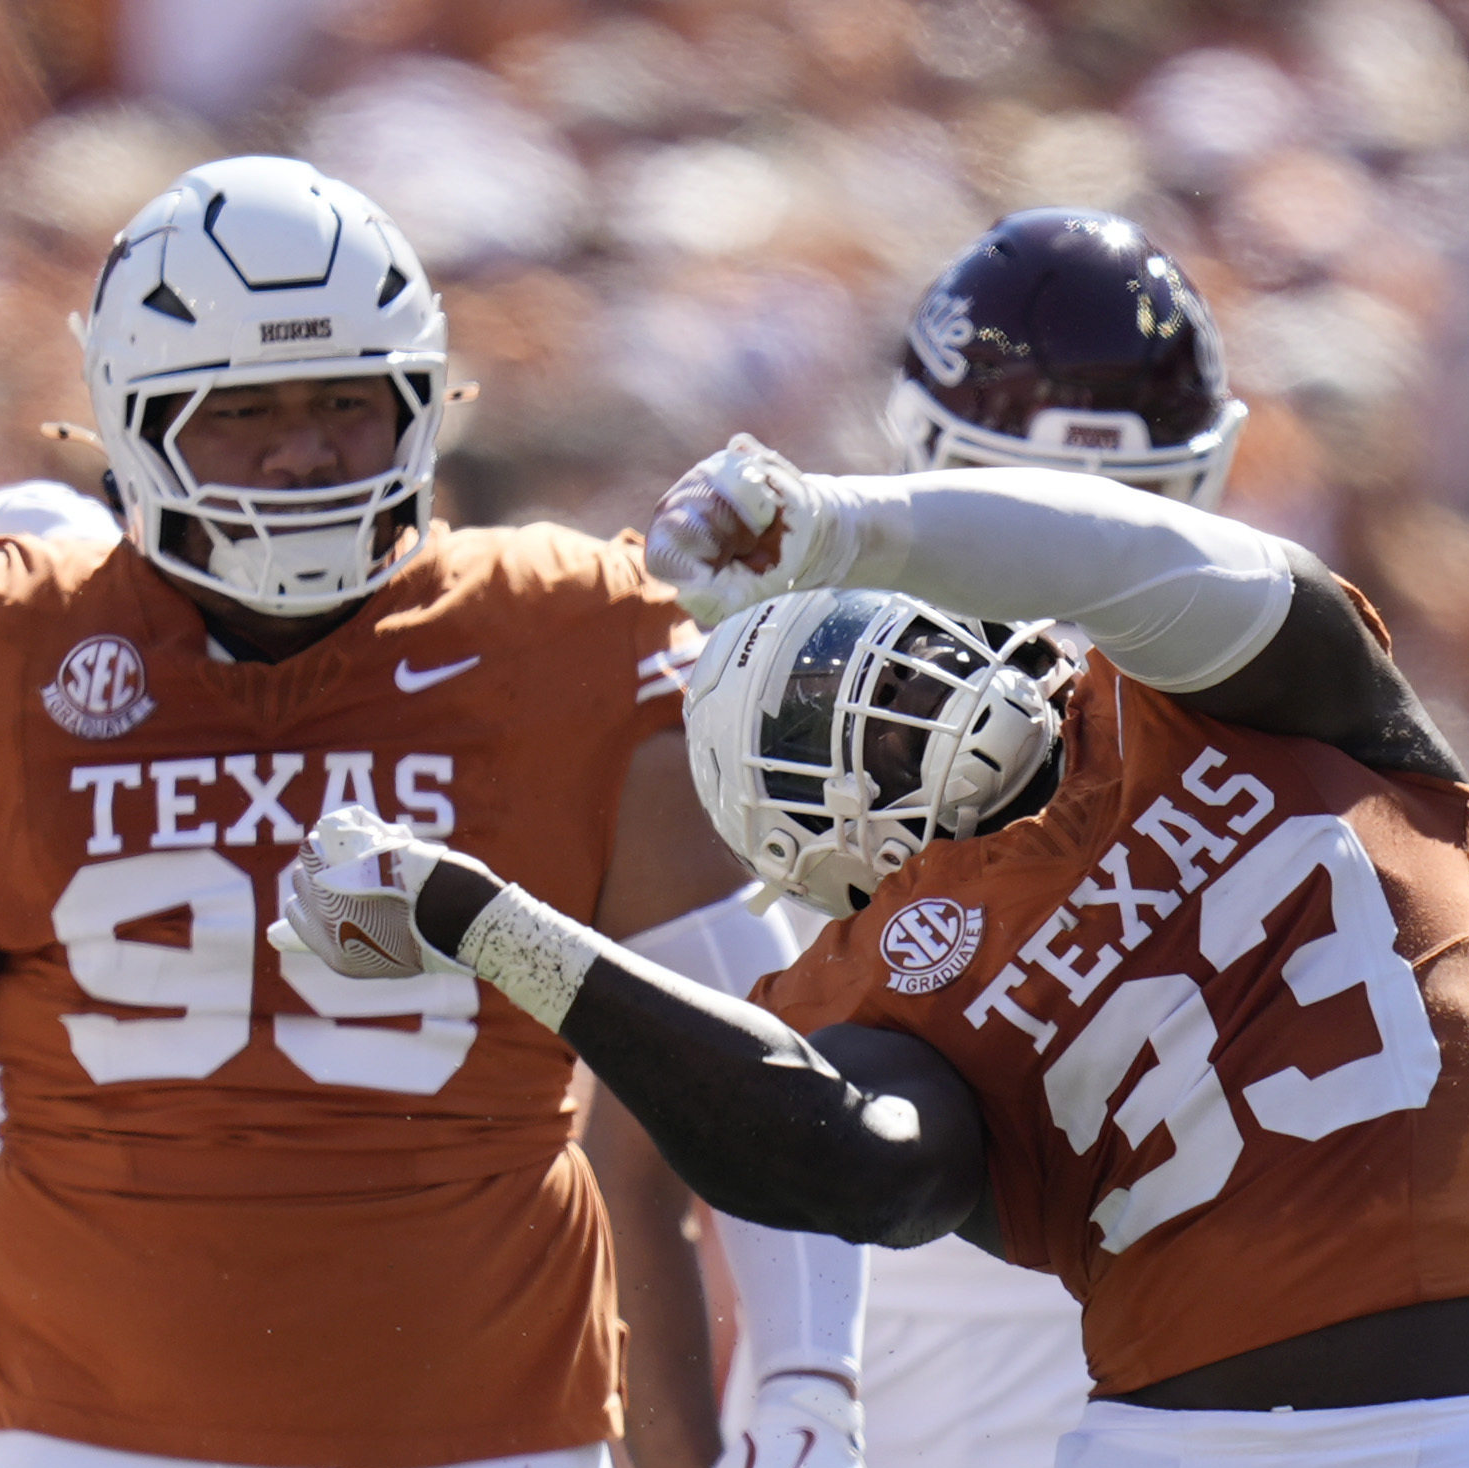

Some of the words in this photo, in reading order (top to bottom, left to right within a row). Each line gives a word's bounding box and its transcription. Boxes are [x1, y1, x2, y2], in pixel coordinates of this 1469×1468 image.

[260, 317, 332, 342] HORNS
[67, 641, 137, 713] SEC
[70, 751, 454, 855] TEXAS
[886, 901, 959, 968] SEC
[964, 746, 1274, 1054] TEXAS
[51, 848, 479, 1095] 99
[906, 928, 981, 992] GRADUATE
[1043, 815, 1441, 1254] 33
